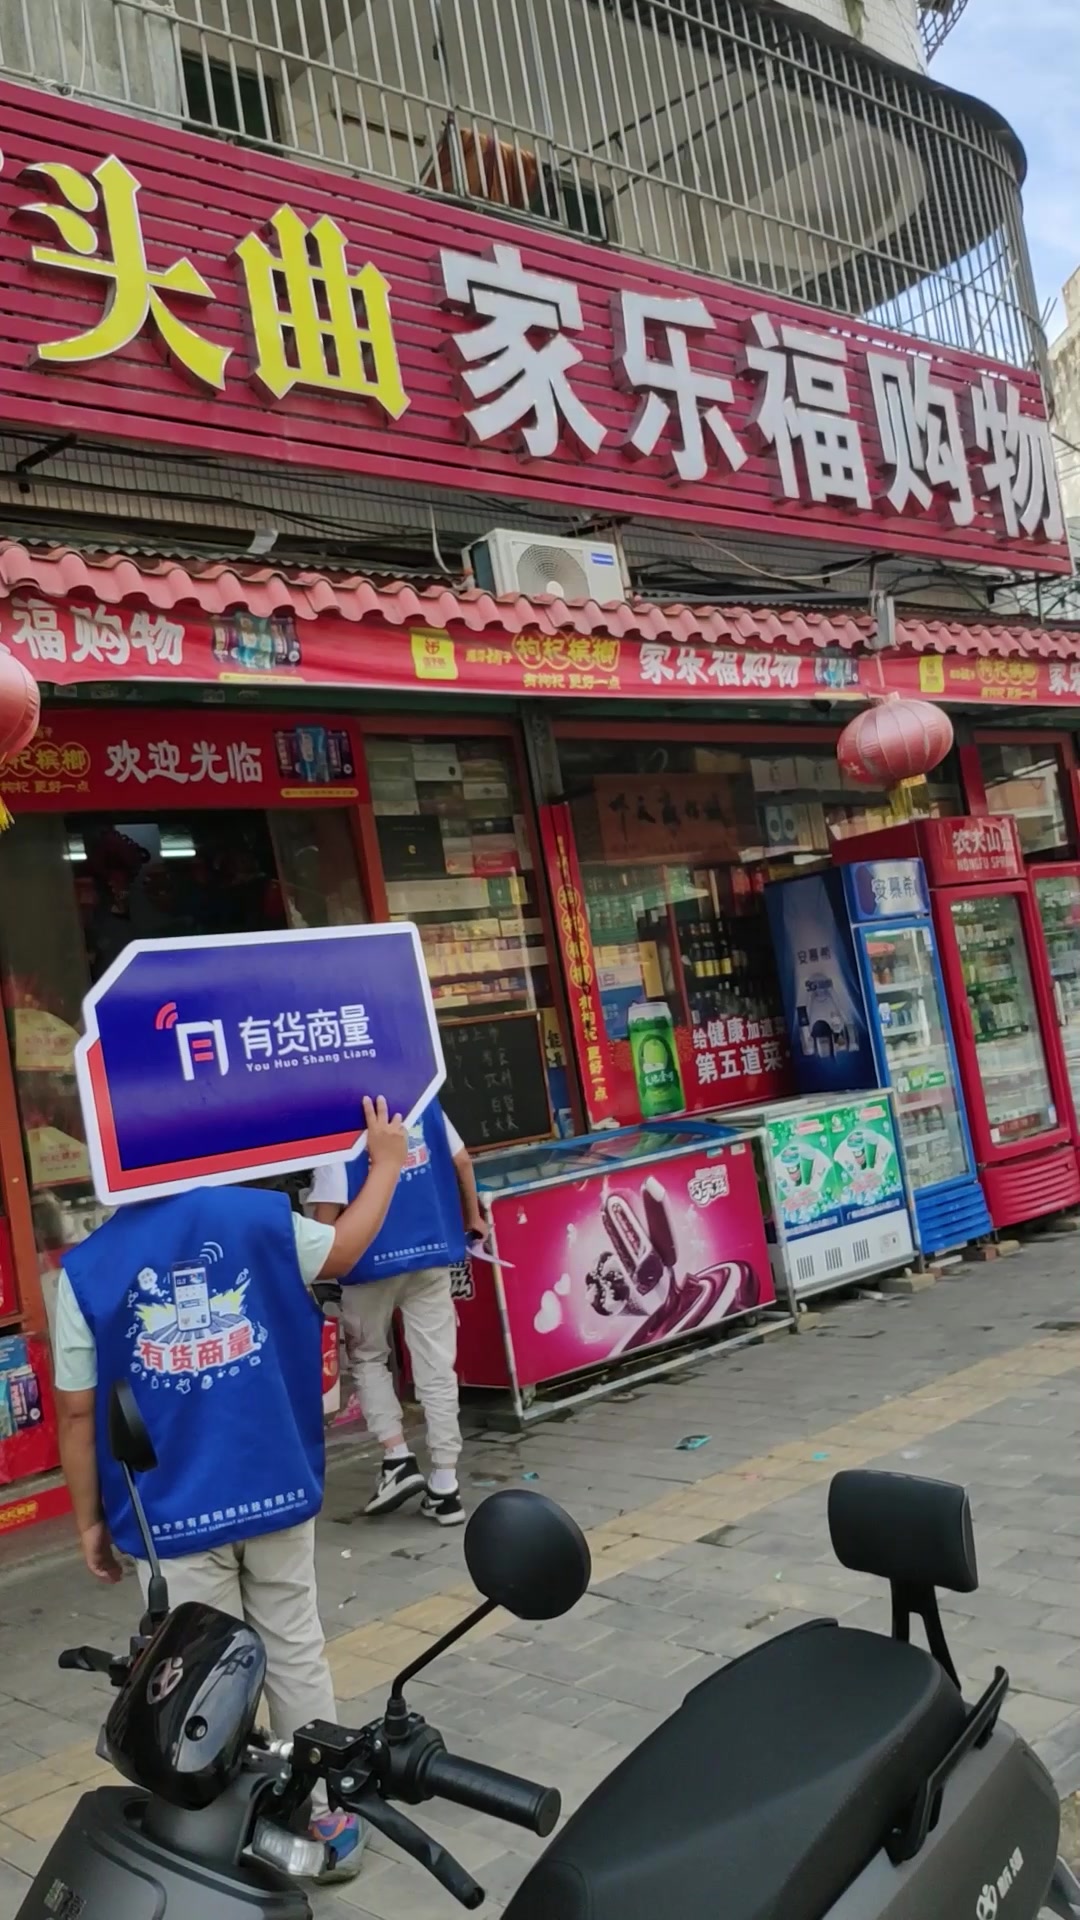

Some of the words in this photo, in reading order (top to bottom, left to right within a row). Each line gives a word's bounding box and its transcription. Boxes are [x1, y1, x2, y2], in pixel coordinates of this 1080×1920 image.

[18, 154, 410, 421] 头曲
[438, 244, 1063, 541] 家乐福购物
[638, 642, 801, 688] 家乐福购物
[104, 740, 263, 783] 欢迎光临
[871, 876, 916, 901] 安慕希
[238, 1003, 374, 1060] 有货商量
[246, 1061, 270, 1073] You
[274, 1057, 299, 1070] Huo
[302, 1053, 341, 1067] Shang
[344, 1047, 377, 1063] Liang
[695, 1041, 783, 1085] 第五道菜
[140, 1324, 254, 1372] 有货商量
